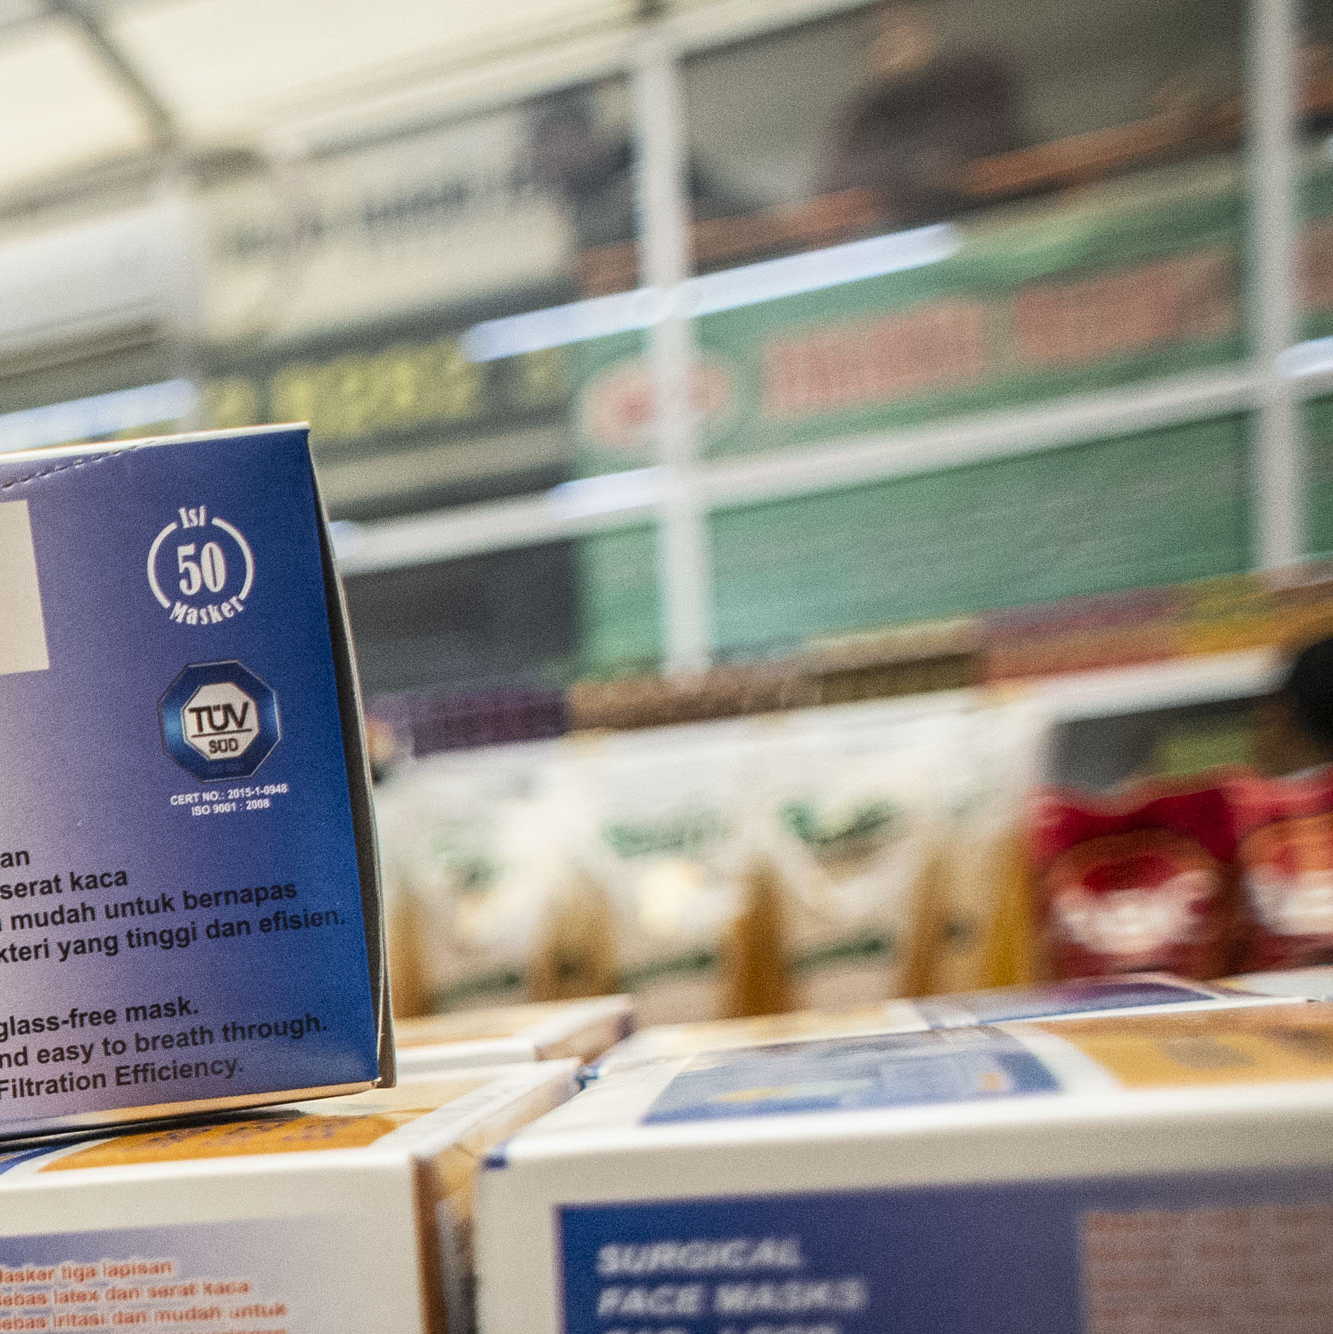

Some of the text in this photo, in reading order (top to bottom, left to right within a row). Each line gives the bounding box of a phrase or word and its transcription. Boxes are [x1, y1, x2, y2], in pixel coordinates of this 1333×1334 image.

[178, 505, 208, 530] Isi
[177, 542, 227, 597] 50
[169, 596, 245, 626] Masker
[188, 701, 250, 734] TÜV
[207, 738, 240, 755] SÜD
[170, 792, 201, 807] CERT
[191, 804, 211, 816] ISO
[213, 802, 237, 814] 9001
[245, 798, 271, 812] 2008
[68, 869, 130, 893] kaca
[9, 901, 97, 932] mudah
[103, 891, 177, 921] untuk
[181, 881, 299, 912] bernapas
[56, 934, 121, 964] yang
[124, 920, 199, 952] tinggi
[204, 917, 253, 941] dan
[257, 907, 346, 935] efisien.
[124, 994, 200, 1024] mask.
[35, 1041, 96, 1066] easy
[100, 1036, 128, 1058] to
[133, 1023, 216, 1054] breath
[220, 1010, 332, 1044] through.
[114, 1057, 245, 1088] Efficiency.
[598, 1239, 801, 1275] SURGICAL
[597, 1280, 867, 1316] FACE MASKS
